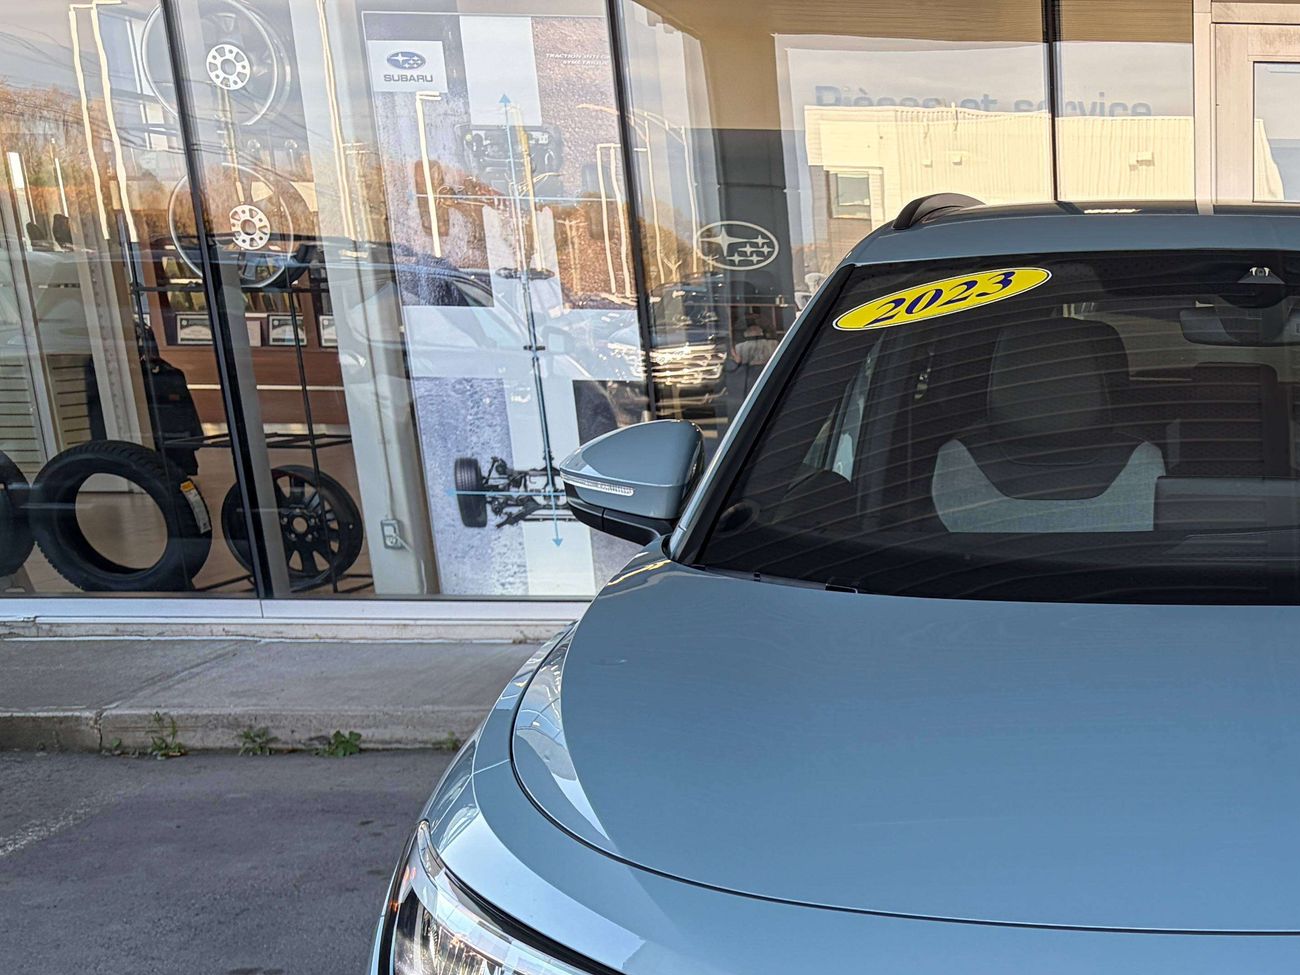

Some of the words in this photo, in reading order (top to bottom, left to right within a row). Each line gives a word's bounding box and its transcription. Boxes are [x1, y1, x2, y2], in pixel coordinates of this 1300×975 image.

[383, 74, 434, 82] SUBARU
[1014, 92, 1152, 117] srvice
[864, 271, 1016, 327] 2023
